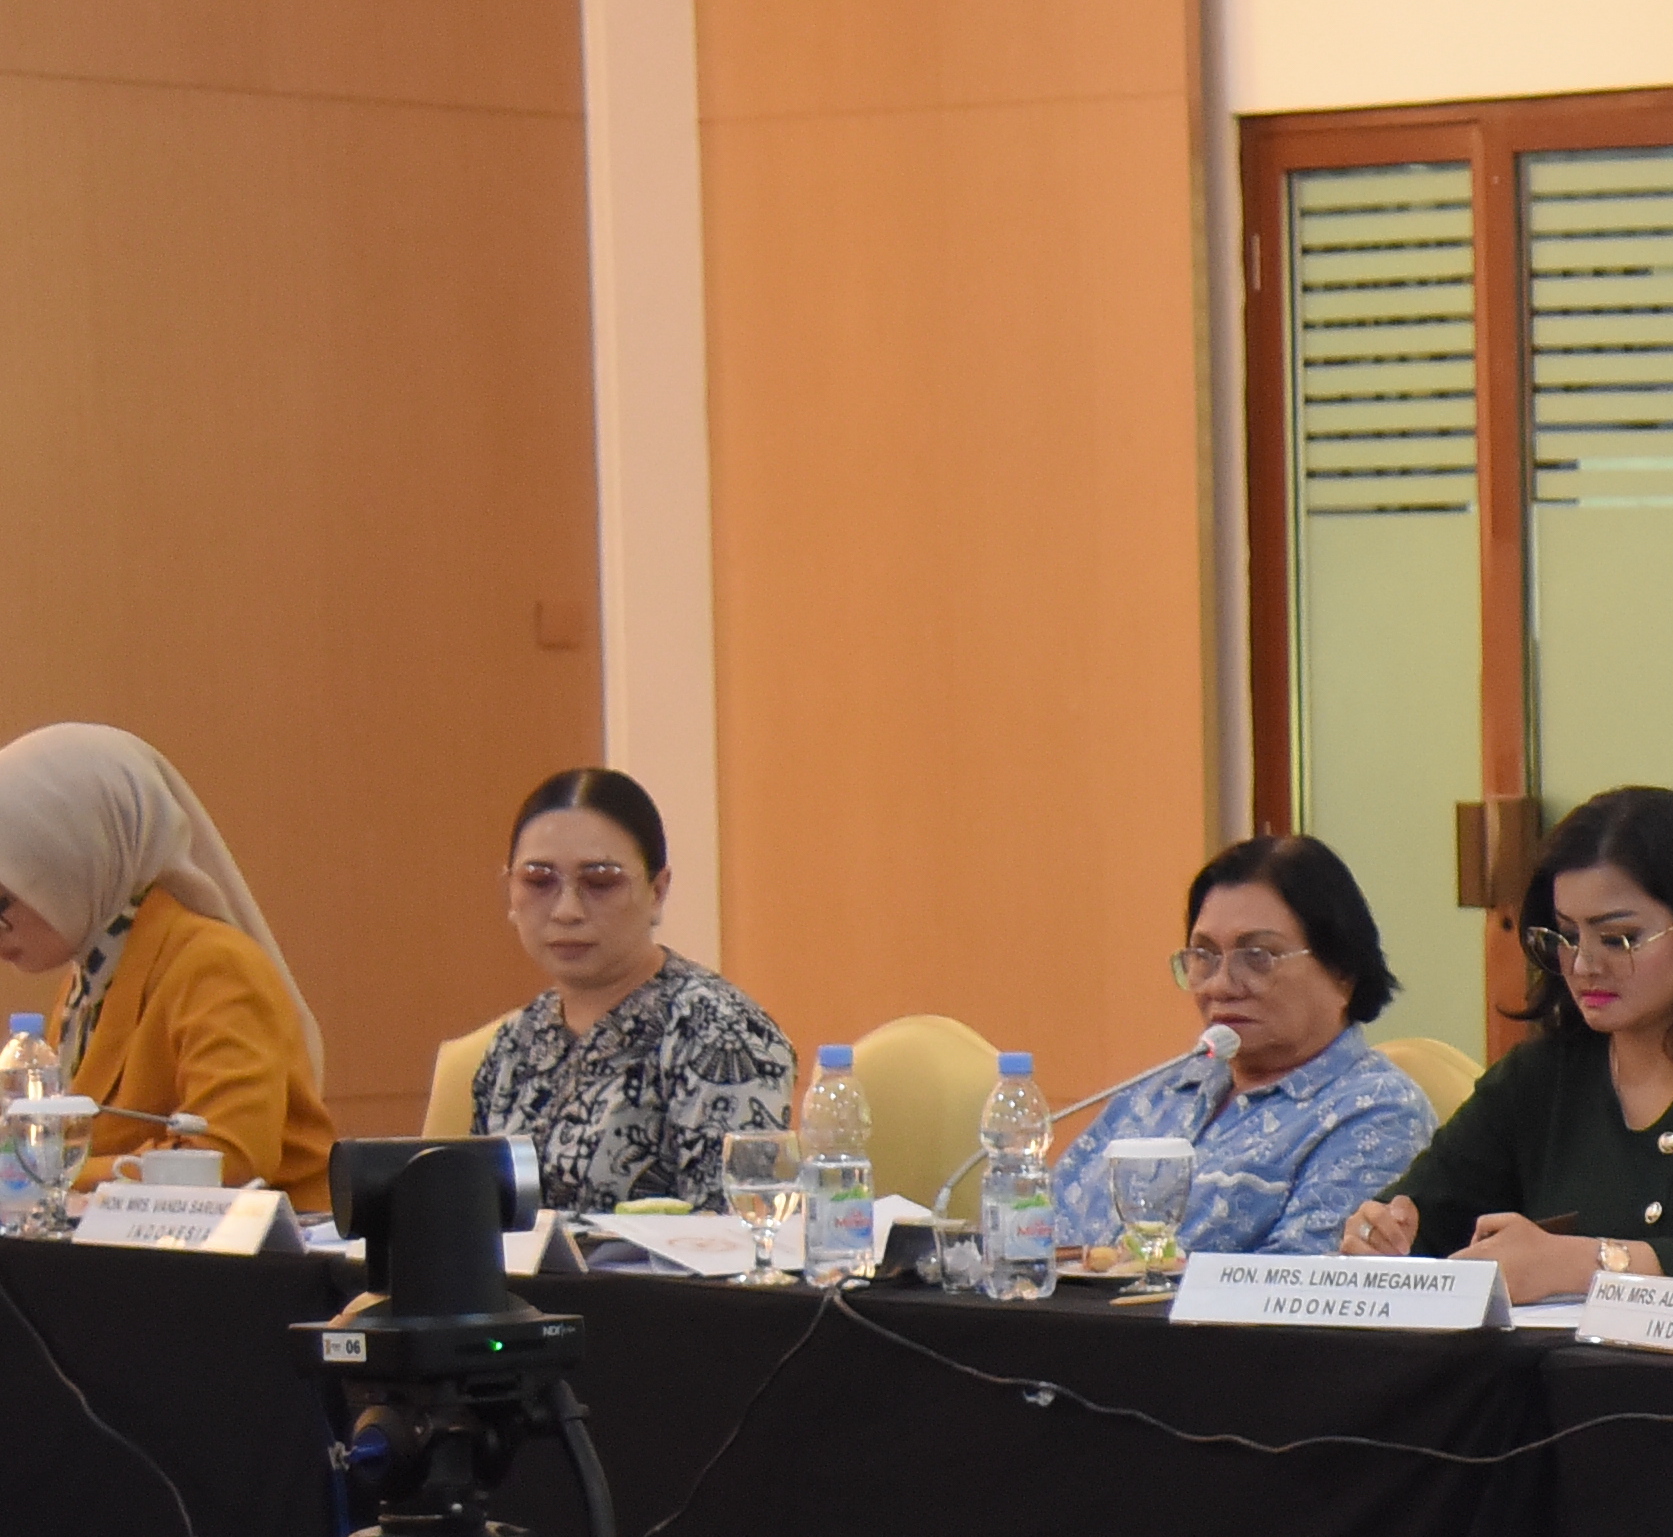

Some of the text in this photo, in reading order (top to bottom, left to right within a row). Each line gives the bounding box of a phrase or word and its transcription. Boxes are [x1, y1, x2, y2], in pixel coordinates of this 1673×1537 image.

[1220, 1266, 1456, 1292] HON. MRS. LINDA MEGAWATI
[1596, 1283, 1624, 1303] HON.
[1627, 1286, 1656, 1306] MRS.
[1263, 1297, 1392, 1318] INDONESIA
[345, 1339, 361, 1355] 06
